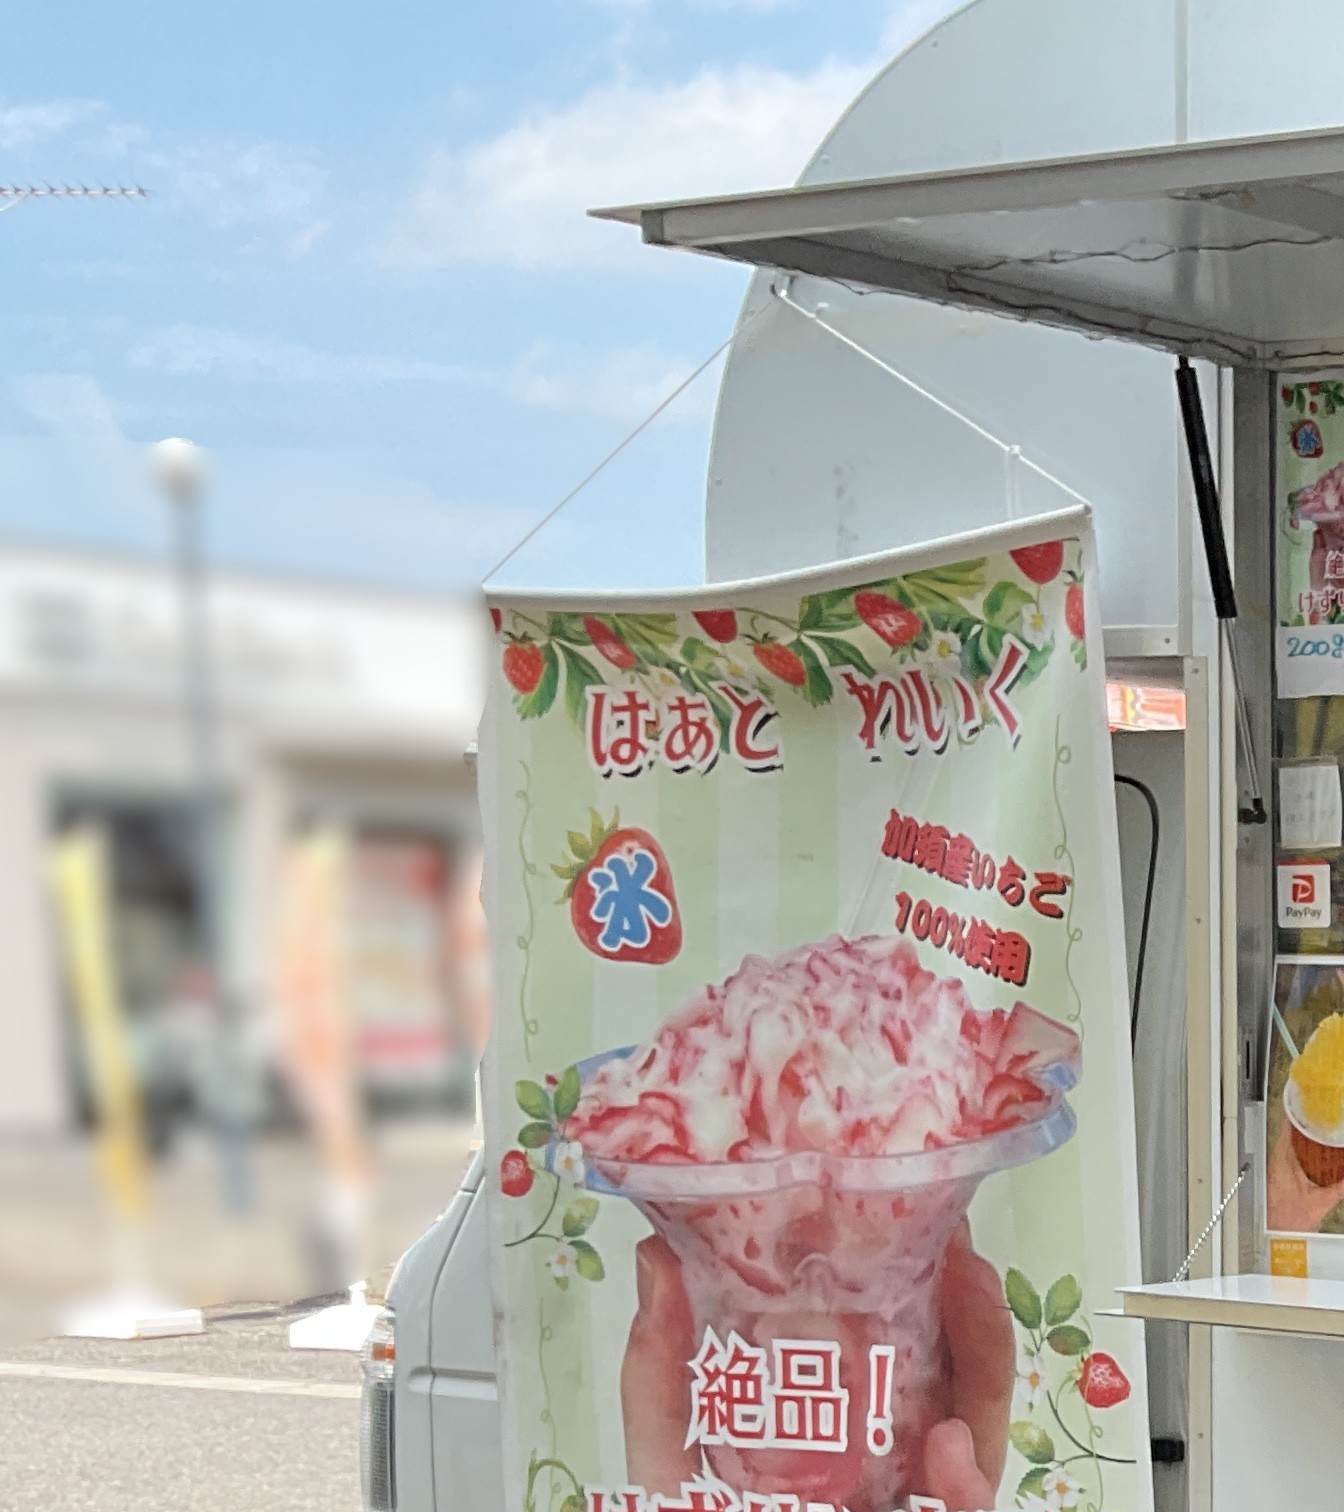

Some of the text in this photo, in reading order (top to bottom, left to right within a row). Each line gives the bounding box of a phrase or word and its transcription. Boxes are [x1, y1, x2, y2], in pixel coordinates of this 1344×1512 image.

[1287, 633, 1344, 659] 200g
[588, 680, 782, 773] はあと
[588, 848, 672, 952] 氷
[895, 890, 1032, 988] 100%使用
[1286, 906, 1322, 918] PayPay
[690, 1331, 896, 1452] 絶品！
